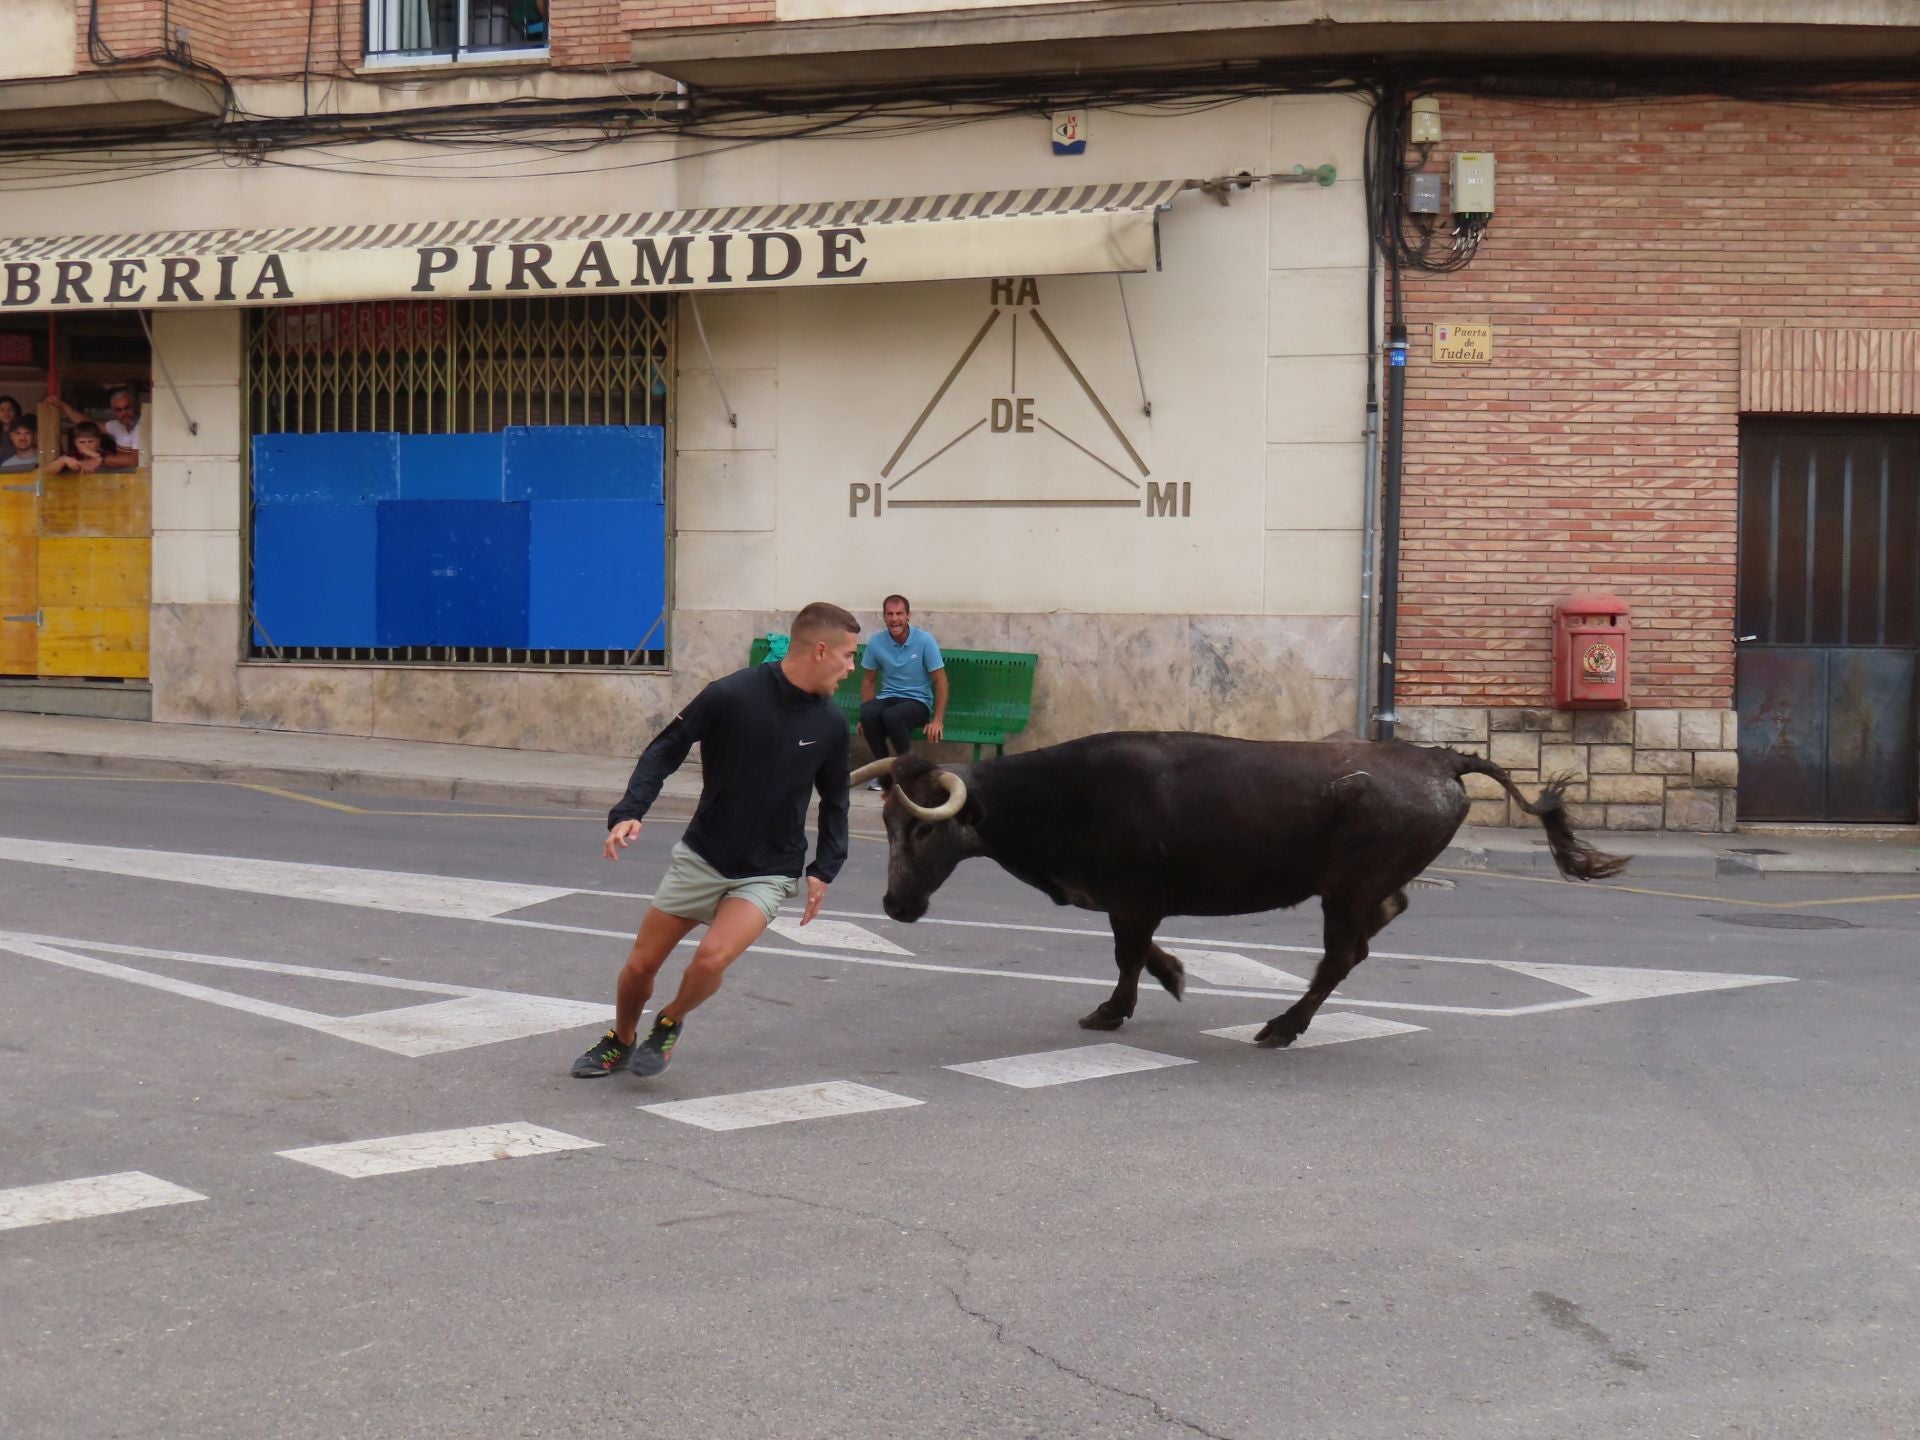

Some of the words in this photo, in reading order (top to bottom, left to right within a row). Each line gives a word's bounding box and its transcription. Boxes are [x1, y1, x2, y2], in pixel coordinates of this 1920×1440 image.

[1, 254, 294, 306] BRERIA
[411, 228, 868, 292] PIRAMIDE
[990, 277, 1040, 306] RA
[1454, 327, 1487, 337] Puerta
[1464, 339, 1475, 347] de
[1440, 348, 1484, 360] Tudela
[991, 398, 1035, 433] DE
[849, 483, 882, 517] PI
[1147, 481, 1191, 517] MI
